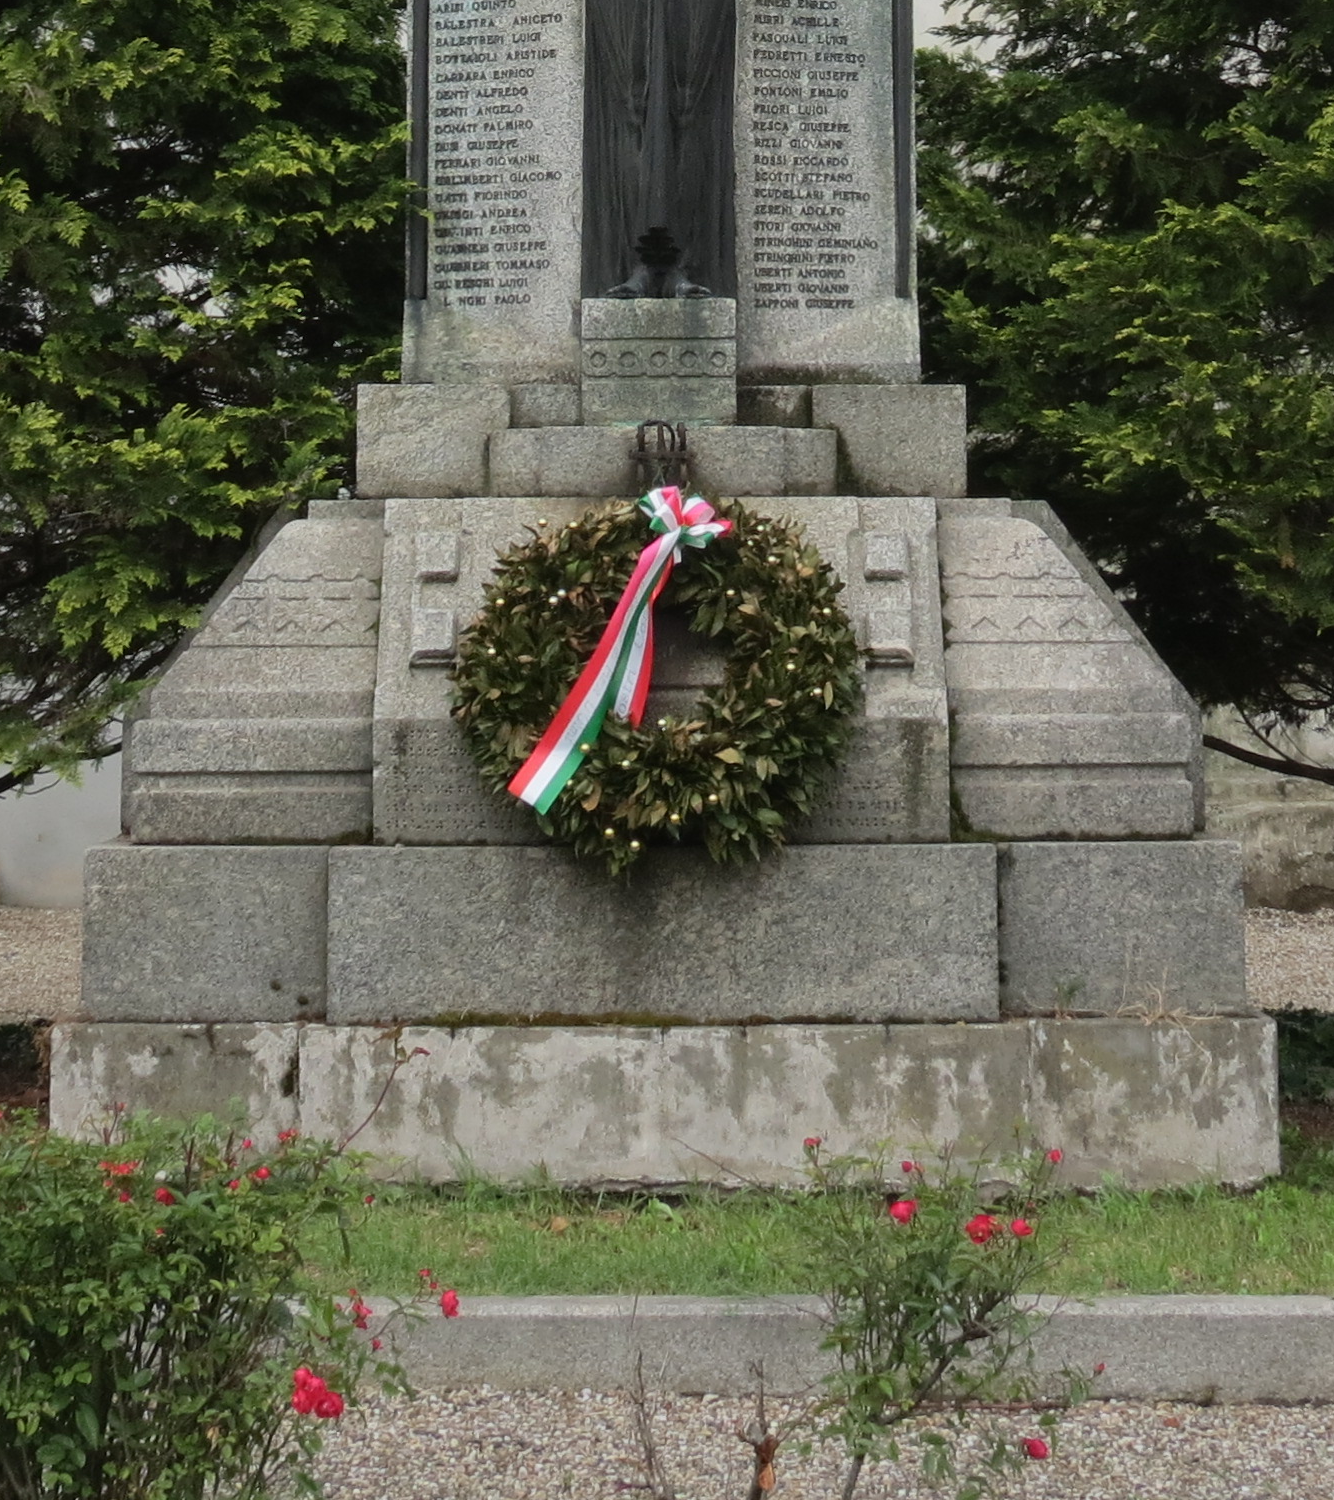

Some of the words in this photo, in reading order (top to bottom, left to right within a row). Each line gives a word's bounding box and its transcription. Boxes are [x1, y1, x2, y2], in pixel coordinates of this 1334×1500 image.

[472, 0, 516, 12] QUINTO
[797, 0, 837, 10] ENRICO
[435, 19, 495, 30] BALESTRA
[512, 14, 563, 25] ANICETO
[791, 16, 839, 27] ACHILLE
[512, 32, 541, 43] LUIGI
[753, 32, 807, 44] PASQUALI
[818, 34, 848, 45] LUIGI
[506, 49, 557, 61] ARISTIDE
[753, 49, 807, 61] PEDRETTI
[815, 52, 866, 64] ERNESTO
[436, 71, 486, 83] CARRARA
[493, 68, 534, 80] ENRICO
[753, 68, 801, 79] PICCIONI
[807, 70, 859, 81] GIUSEPPE
[436, 89, 469, 100] DENTI
[475, 87, 528, 98] ALFREDO
[754, 86, 802, 97] PONZONI
[810, 88, 848, 99] EMILIO
[436, 107, 467, 117] DENTI
[476, 104, 523, 116] ANGELO
[753, 104, 789, 115] PRIORI
[798, 105, 828, 116] LUIGI
[435, 124, 477, 135] DONATI
[484, 120, 533, 132] PALMIRO
[752, 120, 789, 131] RESCA
[799, 122, 851, 133] GIUSEPPE
[467, 139, 519, 150] GIUSEPPE
[754, 138, 782, 148] RIZZI
[789, 139, 843, 149] GIOVANNI
[435, 159, 481, 169] FERRARI
[486, 155, 540, 166] GIOVANNI
[753, 154, 786, 165] ROSSI
[793, 156, 848, 166] RICCARDO
[510, 171, 562, 182] GIACOMO
[754, 171, 795, 182] SCOTTI
[802, 173, 853, 183] STEFANO
[474, 190, 527, 201] FIORINDO
[754, 189, 824, 200] SCUDELLARI
[833, 190, 870, 202] PIETRO
[481, 208, 527, 219] ANDREA
[754, 205, 792, 215] SERENI
[800, 206, 845, 216] ADOLFO
[490, 224, 531, 235] ENRICO
[754, 221, 783, 231] STORI
[791, 222, 841, 232] GIOVANNI
[494, 241, 547, 252] GIUSEPPE
[754, 237, 812, 248] STRINGHINI
[818, 238, 878, 249] GEMINIANO
[754, 252, 812, 263] STRINGHINI
[818, 253, 855, 263] PIETRO
[496, 259, 550, 271] TOMMASO
[754, 268, 791, 278] UBERTI
[798, 269, 845, 279] ANTONIO
[499, 278, 528, 288] LUIGI
[754, 283, 791, 293] UBERTI
[798, 284, 849, 294] GIOVANNI
[494, 294, 531, 305] PAOLO
[754, 299, 799, 309] ZAPPONI
[805, 299, 855, 309] GIUSEPPE
